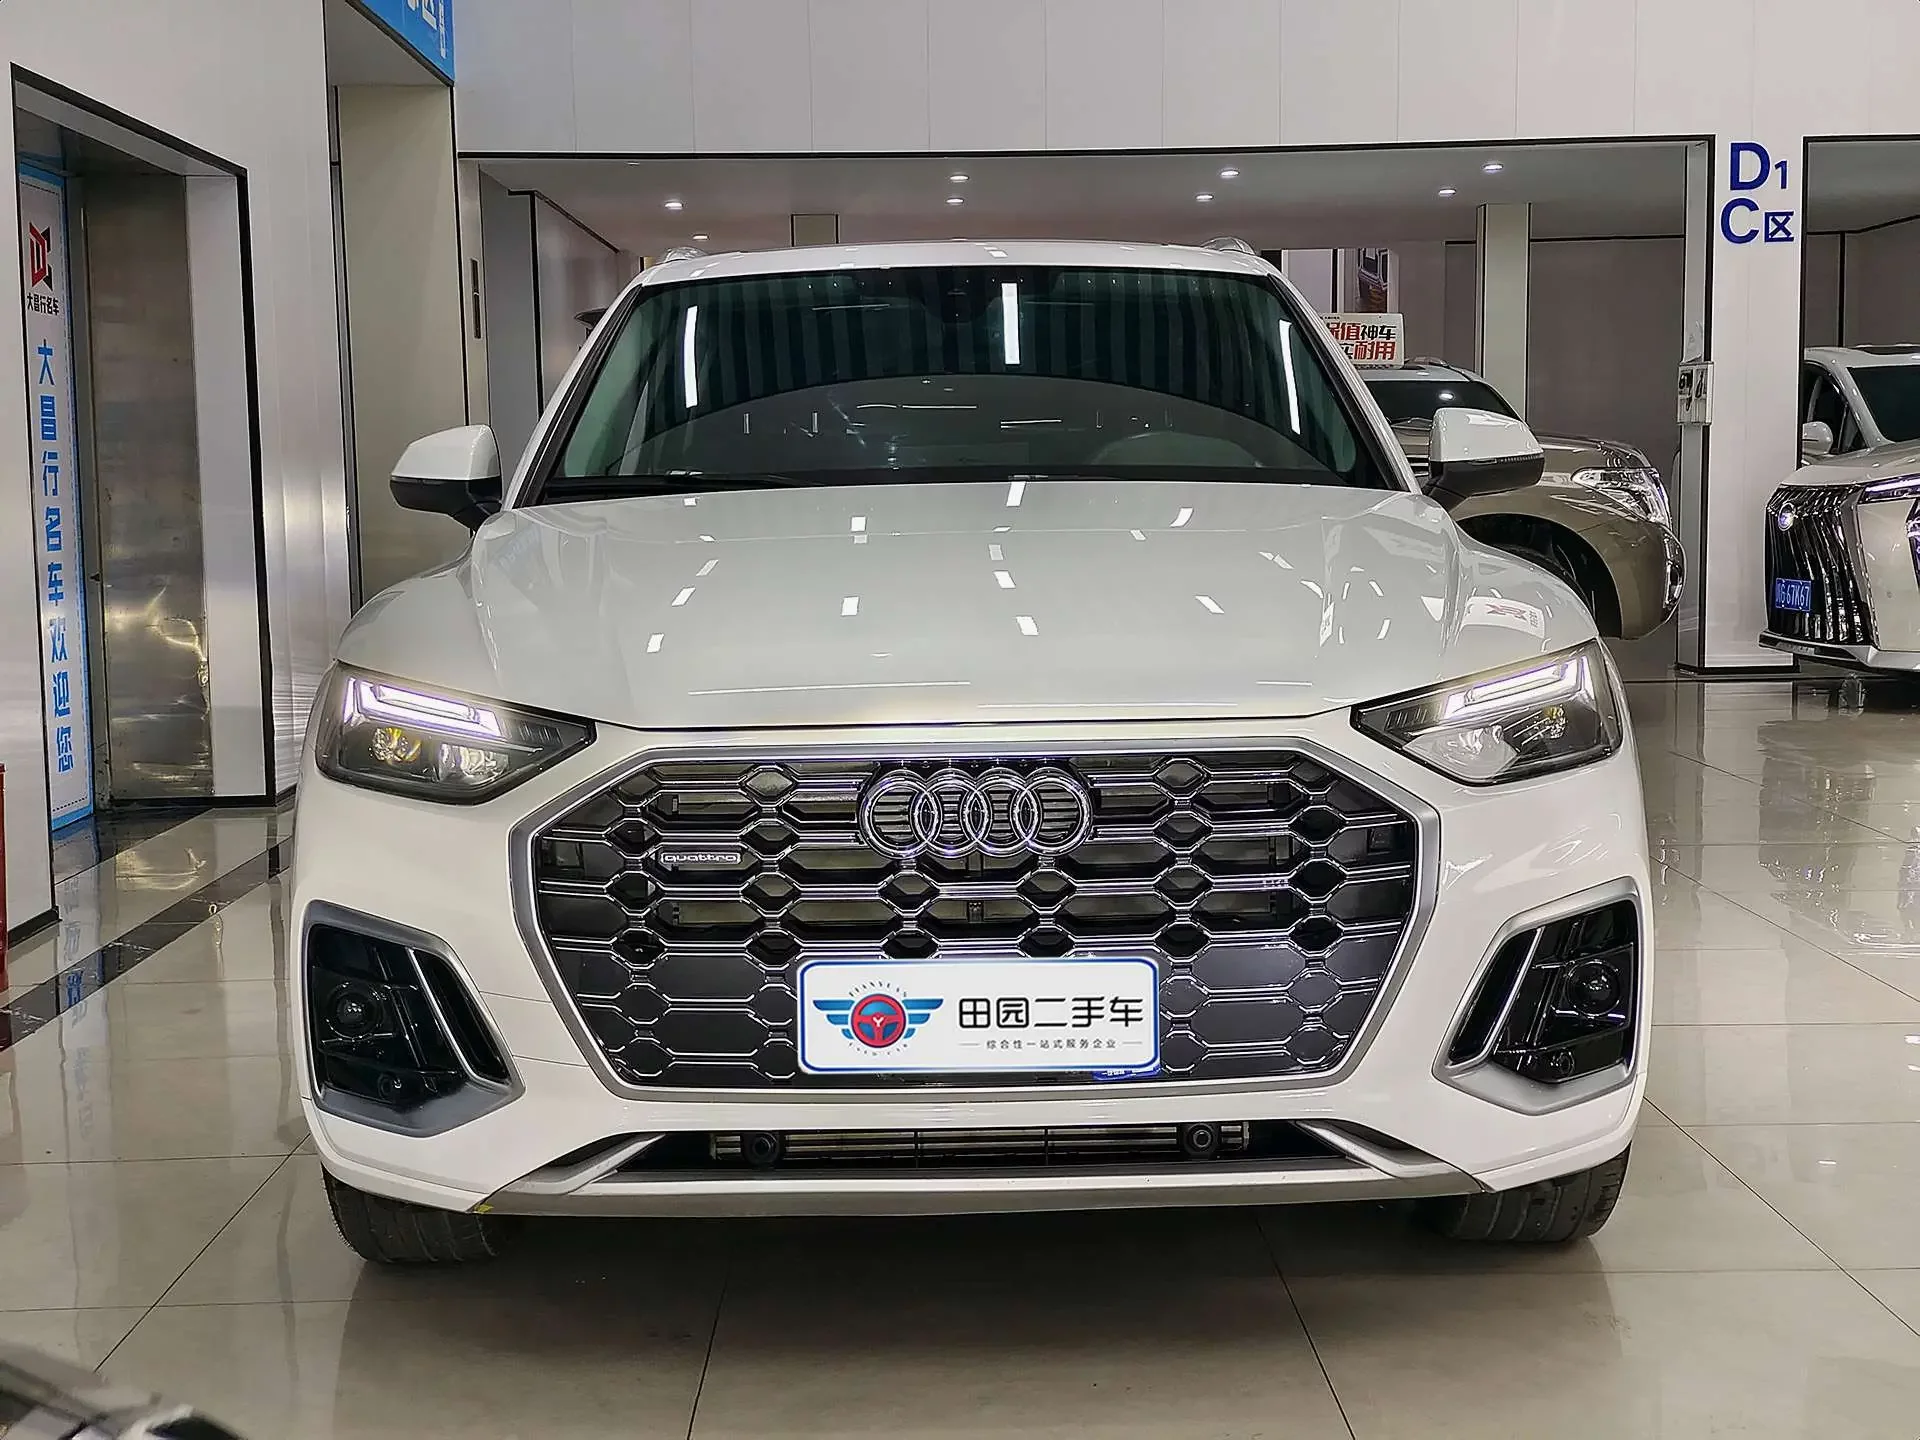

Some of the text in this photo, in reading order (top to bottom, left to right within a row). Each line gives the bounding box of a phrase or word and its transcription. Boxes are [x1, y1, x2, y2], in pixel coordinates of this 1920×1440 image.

[27, 292, 60, 316] 大昌行名车
[664, 853, 737, 863] quattro
[959, 996, 1144, 1029] 田园二手车
[986, 1038, 1116, 1050] 综合性一站式服务企业
